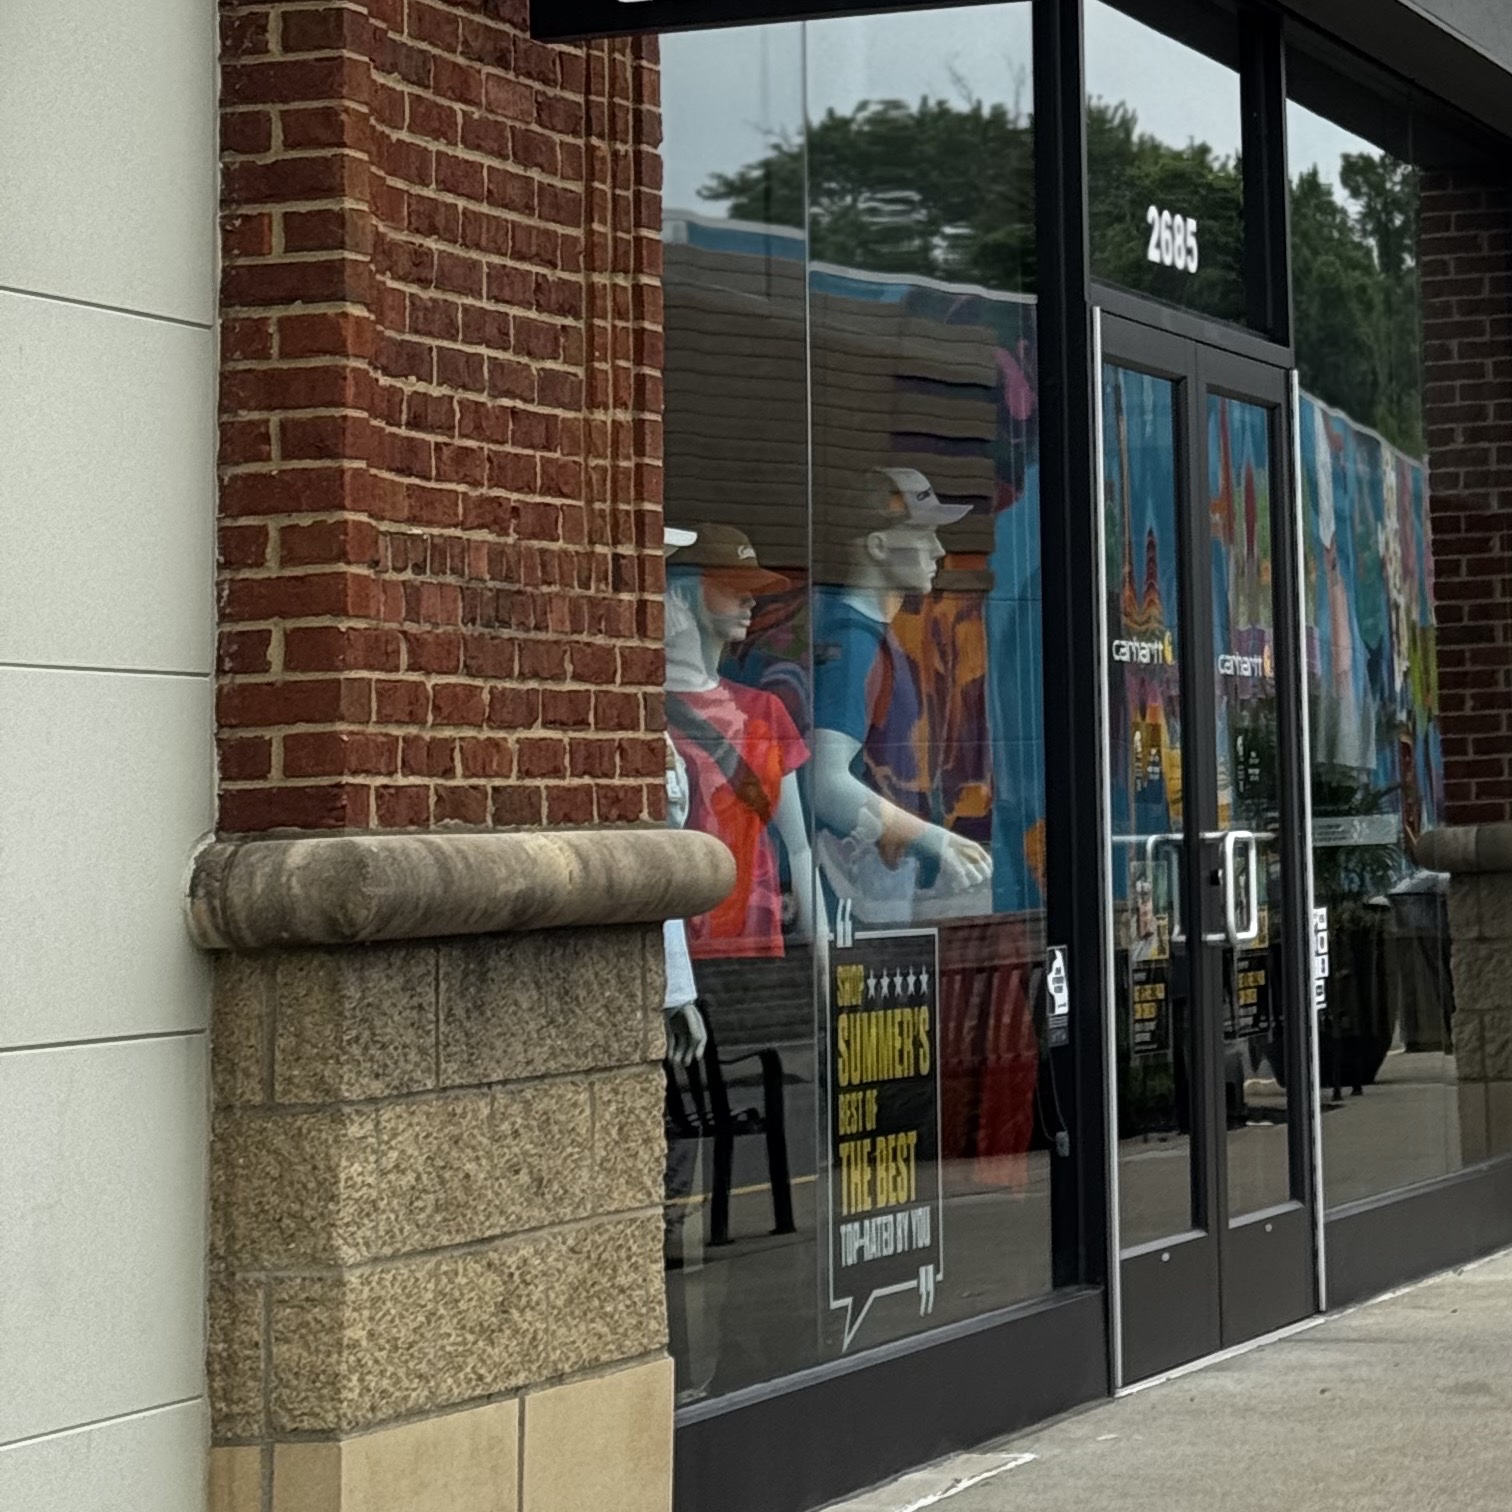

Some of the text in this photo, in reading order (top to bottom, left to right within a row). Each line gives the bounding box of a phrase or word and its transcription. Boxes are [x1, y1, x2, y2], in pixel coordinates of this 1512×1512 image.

[1146, 204, 1199, 275] 2685
[1112, 637, 1164, 664] carhartt
[1218, 653, 1263, 677] carhartt
[837, 1005, 931, 1087] SUMMER'S
[838, 1090, 864, 1136] BEST
[838, 1130, 918, 1217] THE BEST
[896, 1210, 910, 1254] BY
[910, 1205, 931, 1250] YOU
